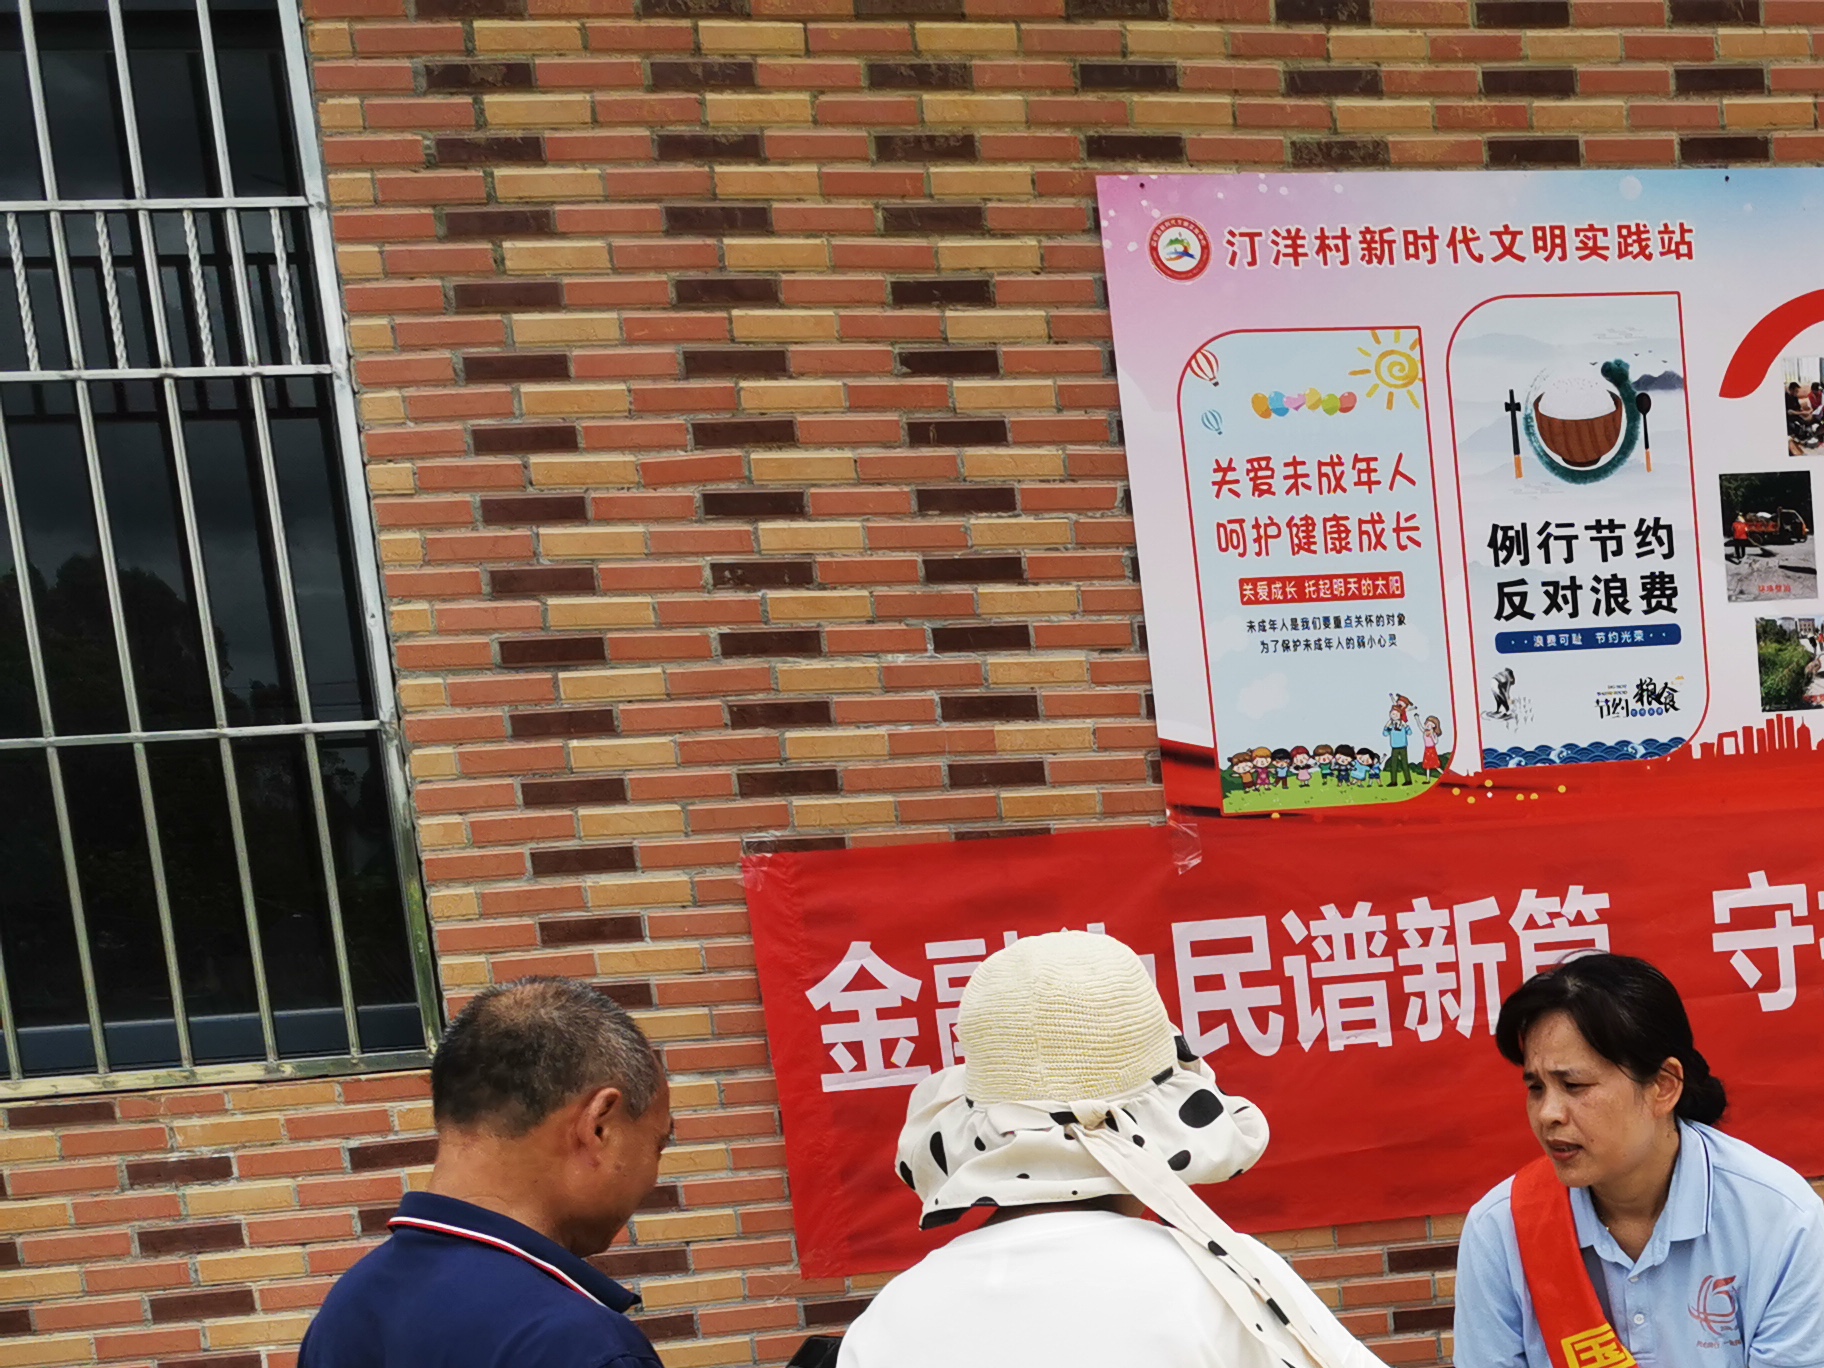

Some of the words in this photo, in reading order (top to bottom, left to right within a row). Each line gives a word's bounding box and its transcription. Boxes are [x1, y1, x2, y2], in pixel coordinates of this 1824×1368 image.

[1226, 220, 1695, 268] 汀洋村新时代文明实践站
[1212, 452, 1417, 499] 关爱未成年人
[1216, 511, 1422, 558] 呵护健康成长
[1488, 517, 1675, 568] 例行节约
[1242, 580, 1298, 602] 关爱成长
[1304, 576, 1401, 599] 托起明天的太阳
[1494, 571, 1680, 622] 反对浪费
[1246, 612, 1407, 634] 未成年人是我们要重点关怀的对象
[1260, 633, 1398, 654] 为了保护未成年人的弱小心灵
[1533, 632, 1583, 648] 浪费可耻
[1595, 630, 1645, 644] 节约光荣
[805, 884, 1610, 1092] 金民谱新篇
